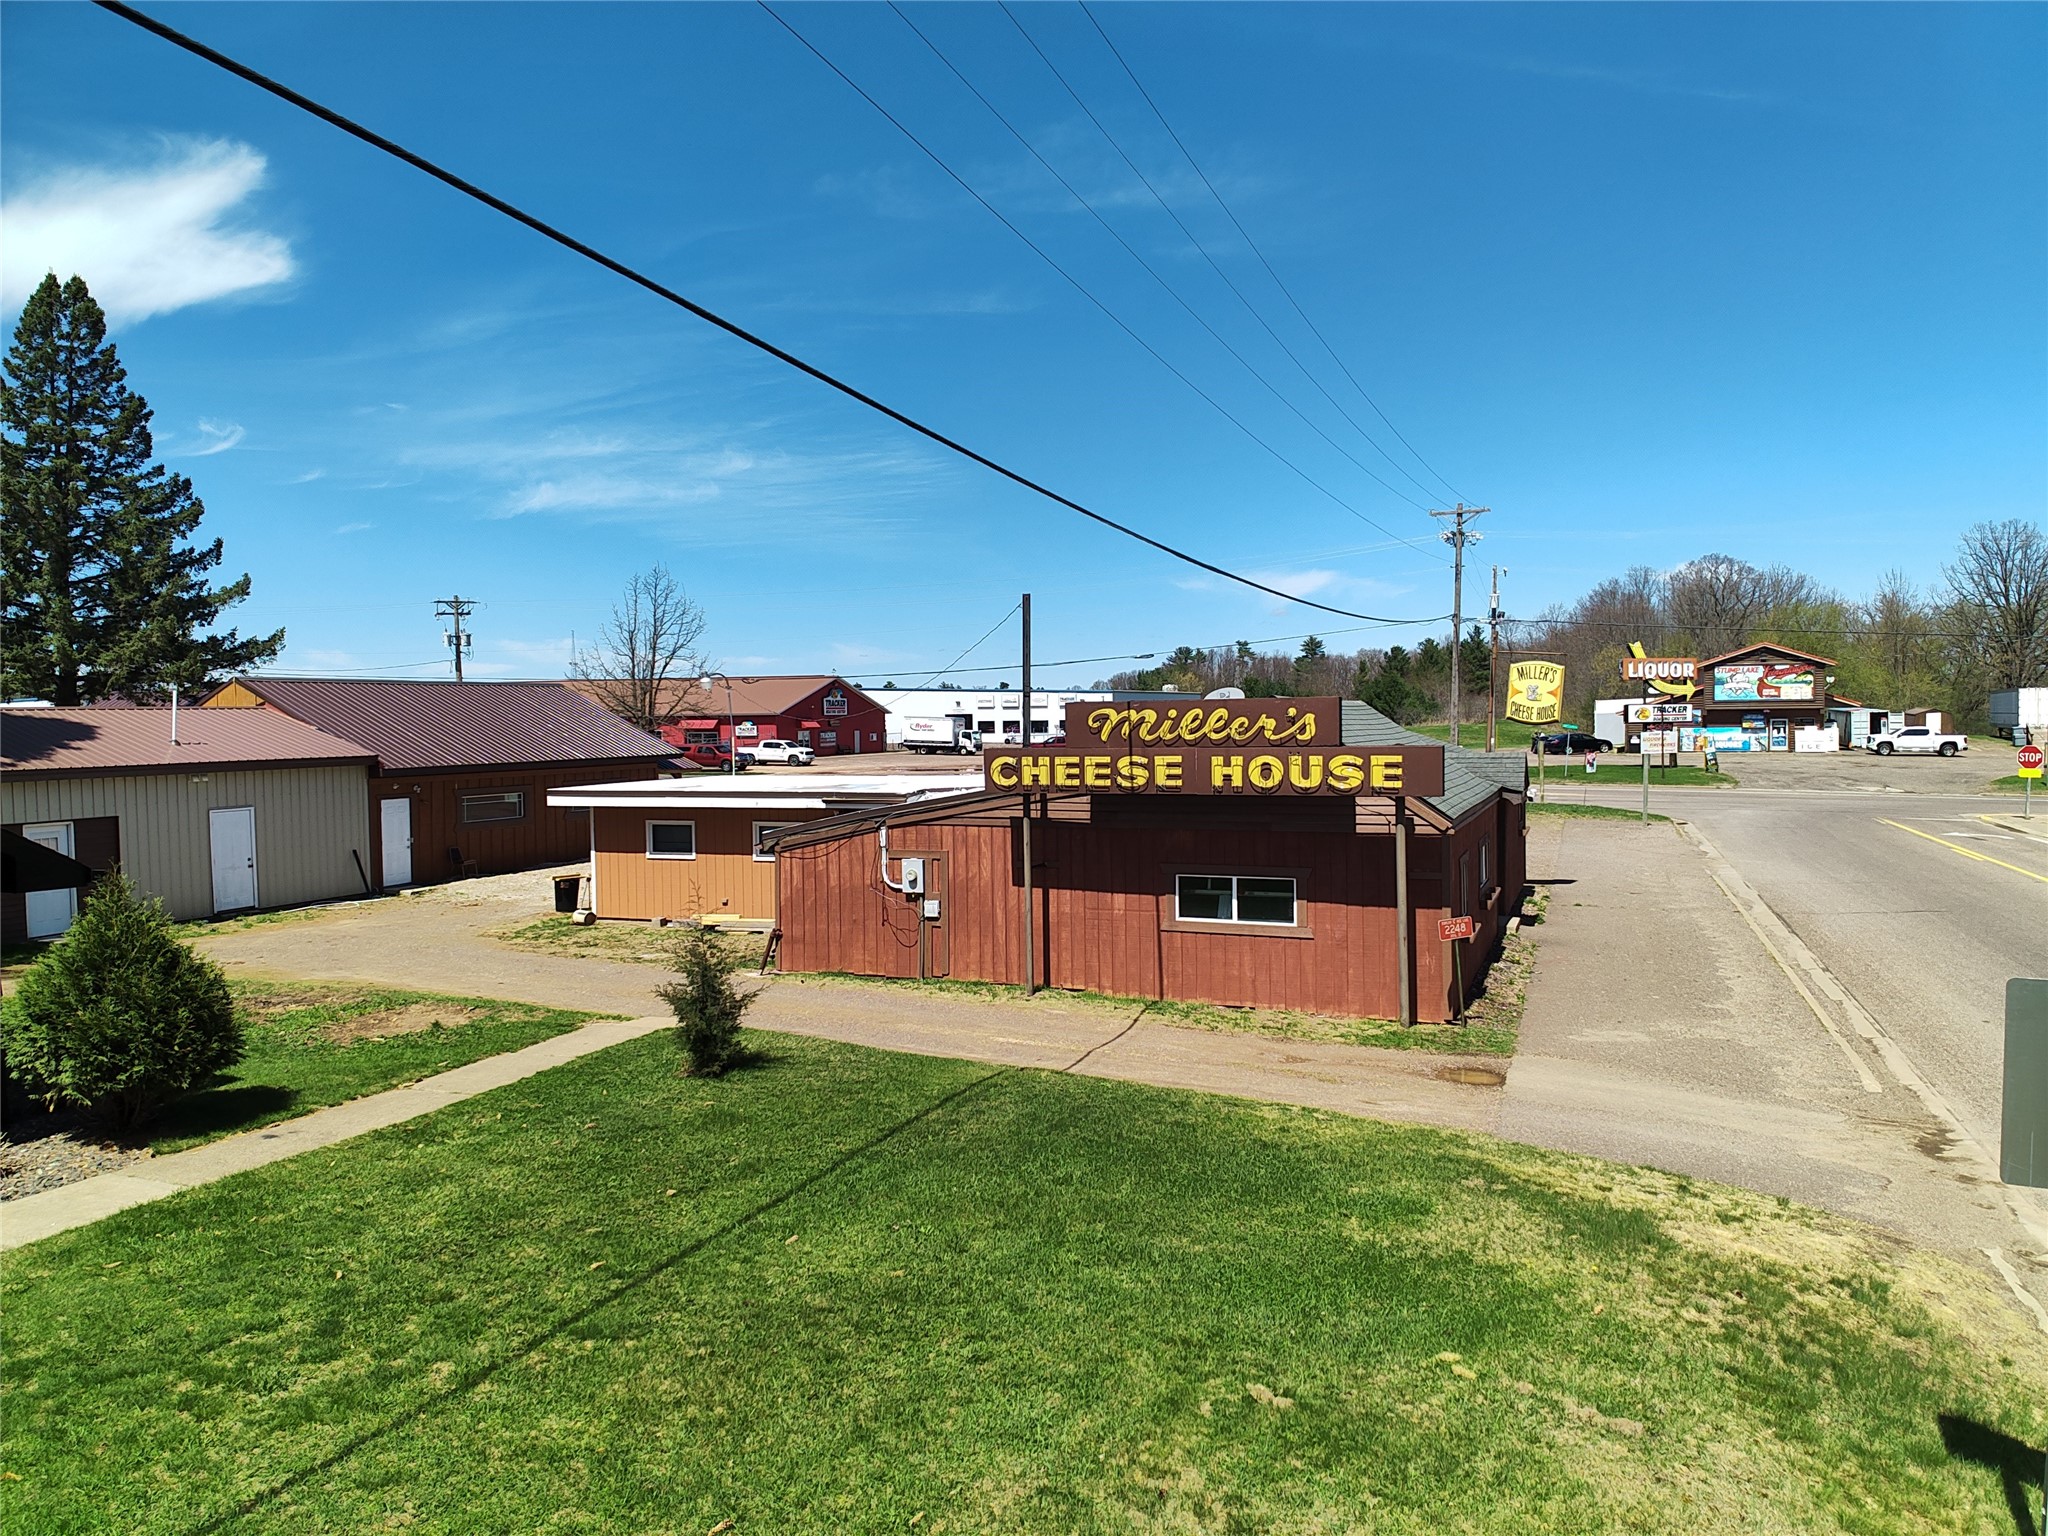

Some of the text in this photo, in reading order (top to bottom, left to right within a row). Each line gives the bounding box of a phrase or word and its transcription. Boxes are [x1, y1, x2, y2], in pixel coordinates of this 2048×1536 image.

[1517, 665, 1557, 683] MILLER'S
[1628, 661, 1695, 679] LIQUOR
[1510, 701, 1557, 720] CHEESE HOUSE
[1653, 705, 1688, 713] TRACKER
[1086, 706, 1318, 745] Miller's
[2019, 752, 2042, 762] STOP
[989, 754, 1404, 790] CHEESE HOUSE
[1444, 922, 1467, 935] 2248
